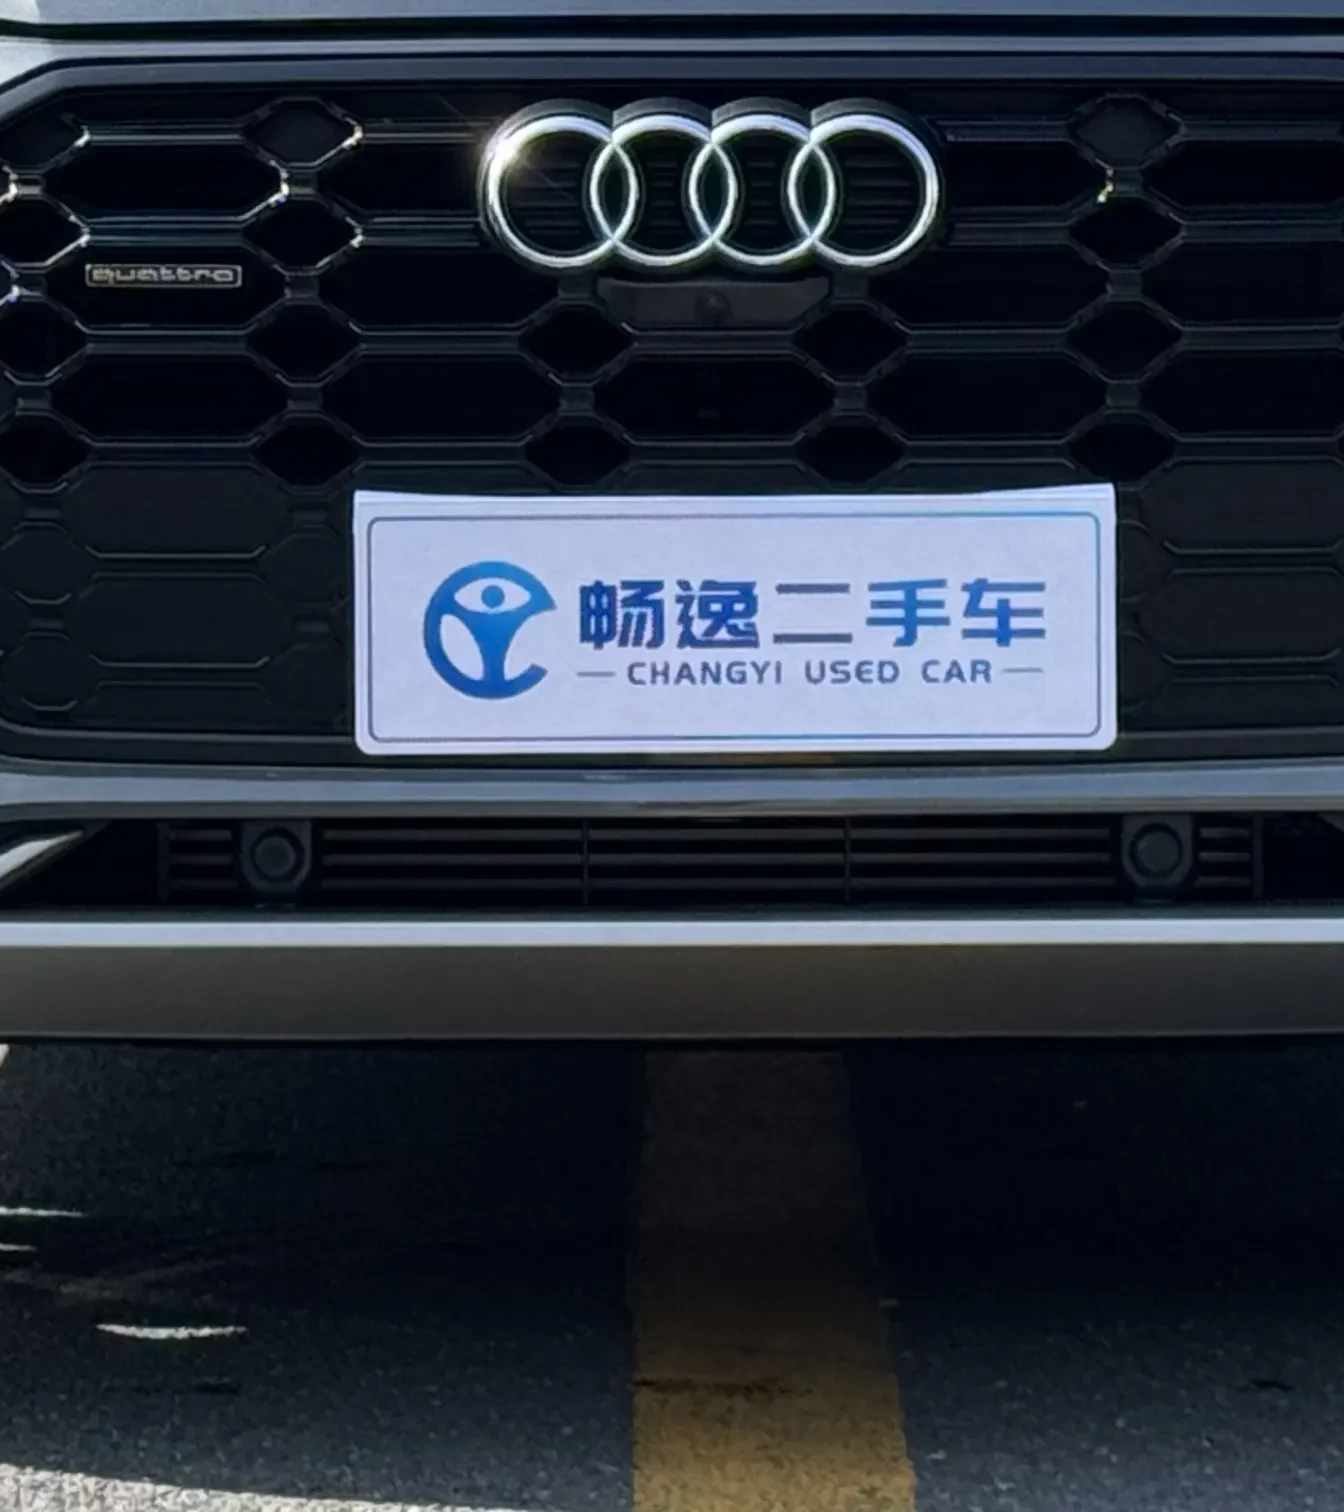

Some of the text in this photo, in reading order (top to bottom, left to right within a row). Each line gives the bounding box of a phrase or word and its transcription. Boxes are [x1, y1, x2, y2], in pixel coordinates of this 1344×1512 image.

[93, 267, 234, 285] quattro
[579, 578, 1047, 649] 畅逸二手车
[626, 659, 993, 686] CHANGYI USED CAR
